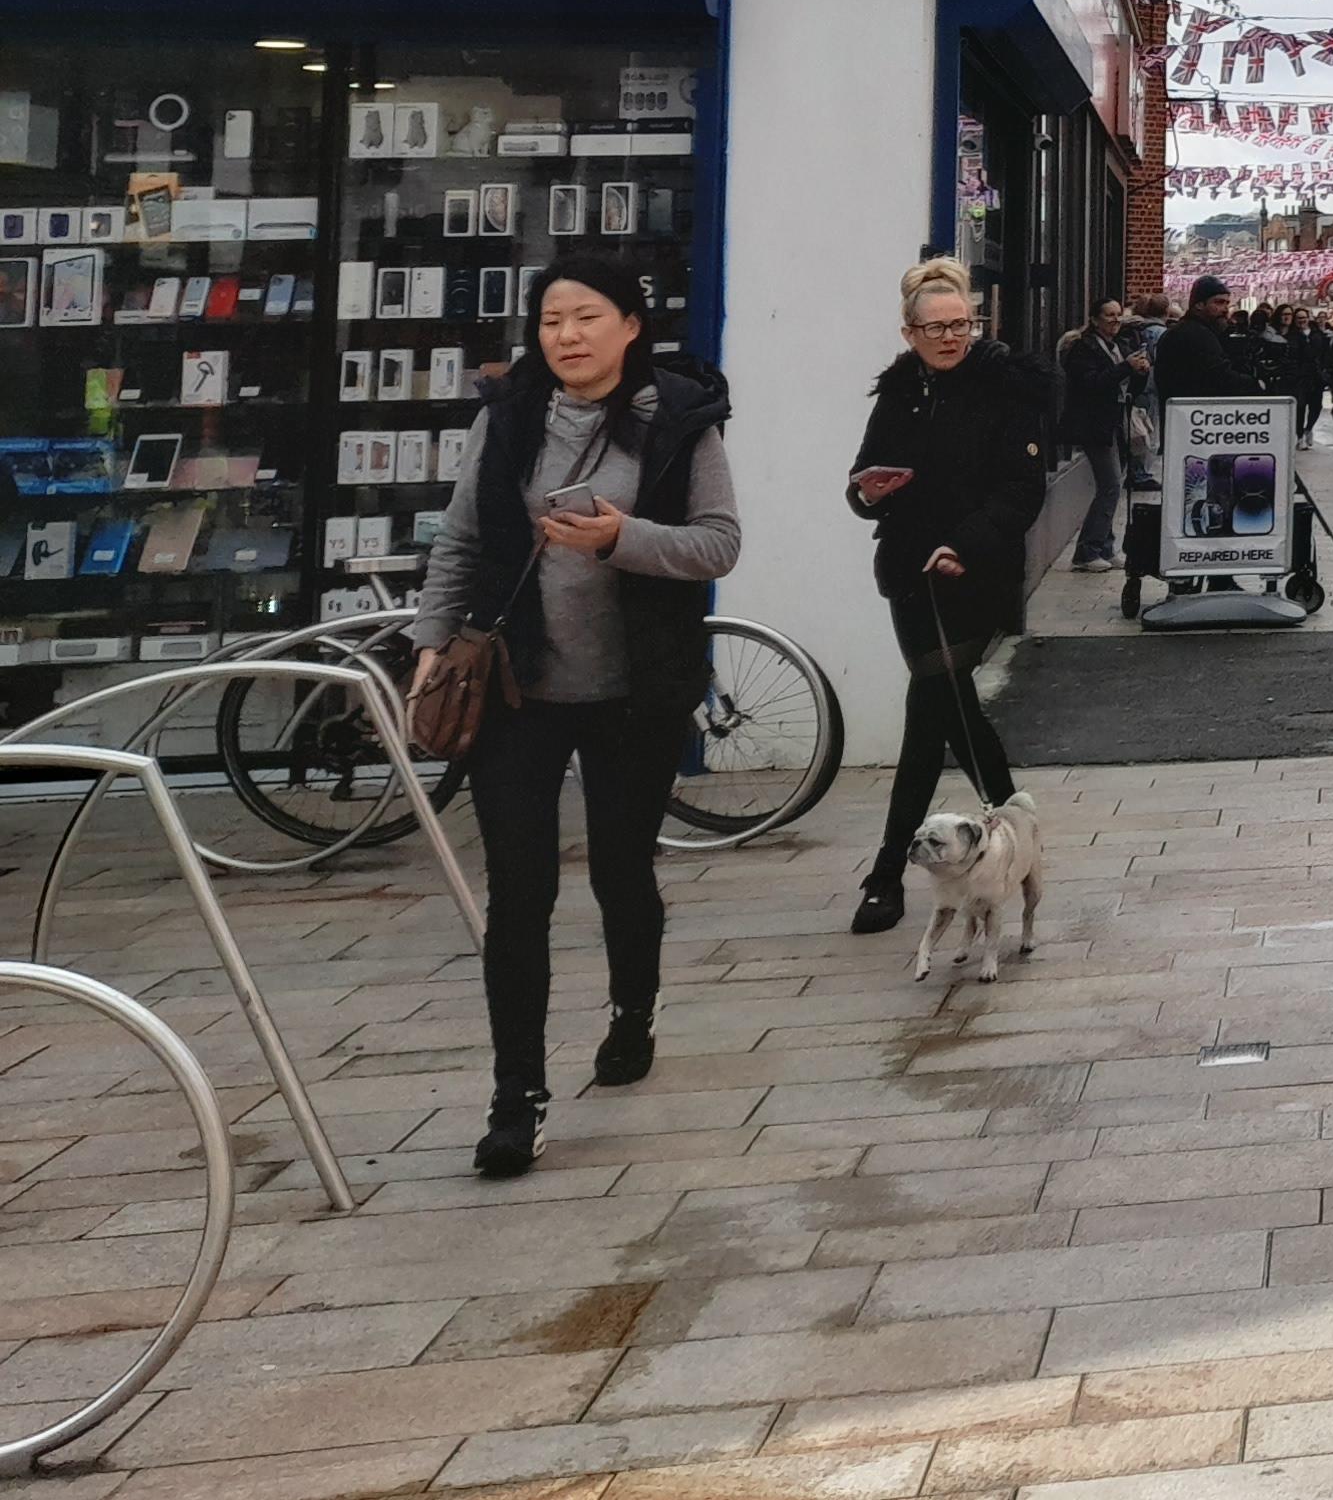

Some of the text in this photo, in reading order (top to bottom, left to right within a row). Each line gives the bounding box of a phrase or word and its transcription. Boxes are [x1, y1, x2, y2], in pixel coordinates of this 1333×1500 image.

[1190, 409, 1271, 426] Cracked
[1190, 429, 1270, 445] Screens
[1179, 550, 1274, 562] REPAIRED HERE
